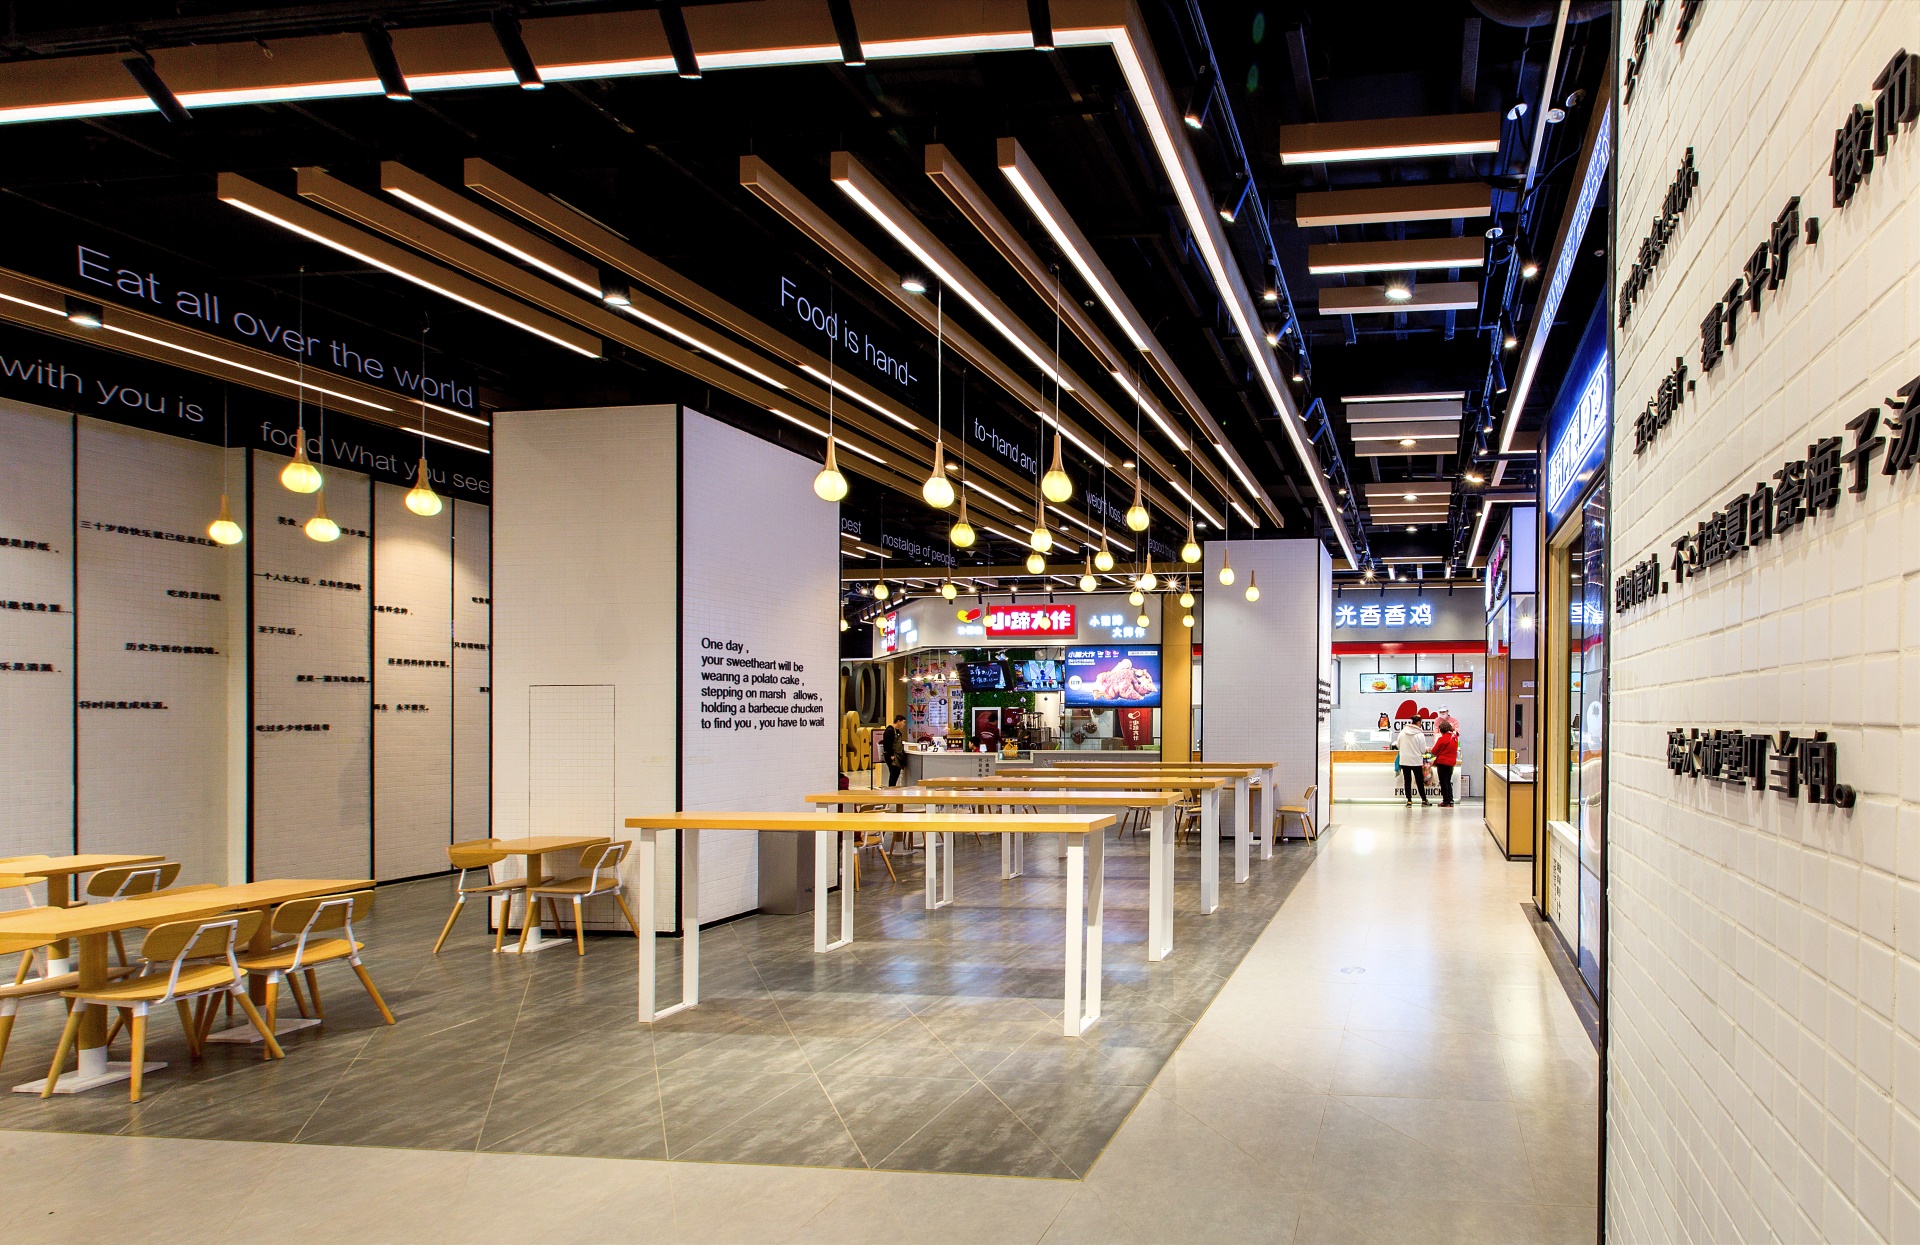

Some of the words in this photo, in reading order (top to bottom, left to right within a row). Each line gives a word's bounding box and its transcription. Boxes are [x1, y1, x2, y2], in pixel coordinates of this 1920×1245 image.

[76, 245, 162, 304] Eat
[175, 287, 220, 324] all
[233, 311, 320, 357] over
[330, 339, 385, 380] the
[393, 365, 475, 410] world
[781, 276, 838, 341] Food
[844, 320, 860, 354] is
[865, 334, 918, 387] hand-
[0, 355, 82, 394] with
[97, 379, 166, 414] you
[177, 395, 205, 423] is
[974, 417, 1019, 463] to-hand
[331, 438, 398, 475] What
[453, 473, 490, 494] see
[1108, 501, 1121, 523] loss
[882, 534, 921, 556] nostalgia
[922, 545, 931, 557] of
[1335, 603, 1432, 627] 光香香鸡
[701, 637, 723, 650] One
[701, 655, 724, 667] your
[726, 657, 777, 670] sweetheart
[778, 661, 791, 671] will
[793, 662, 804, 673] be
[743, 675, 749, 683] a
[701, 686, 743, 700] stepping
[745, 689, 757, 698] on
[759, 688, 786, 699] marsh
[701, 702, 737, 715] holding
[740, 705, 745, 713] a
[748, 702, 789, 714] barbecue
[701, 718, 711, 729] to
[714, 717, 731, 729] find
[759, 718, 775, 730] you
[777, 717, 798, 727] have
[799, 717, 807, 727] to
